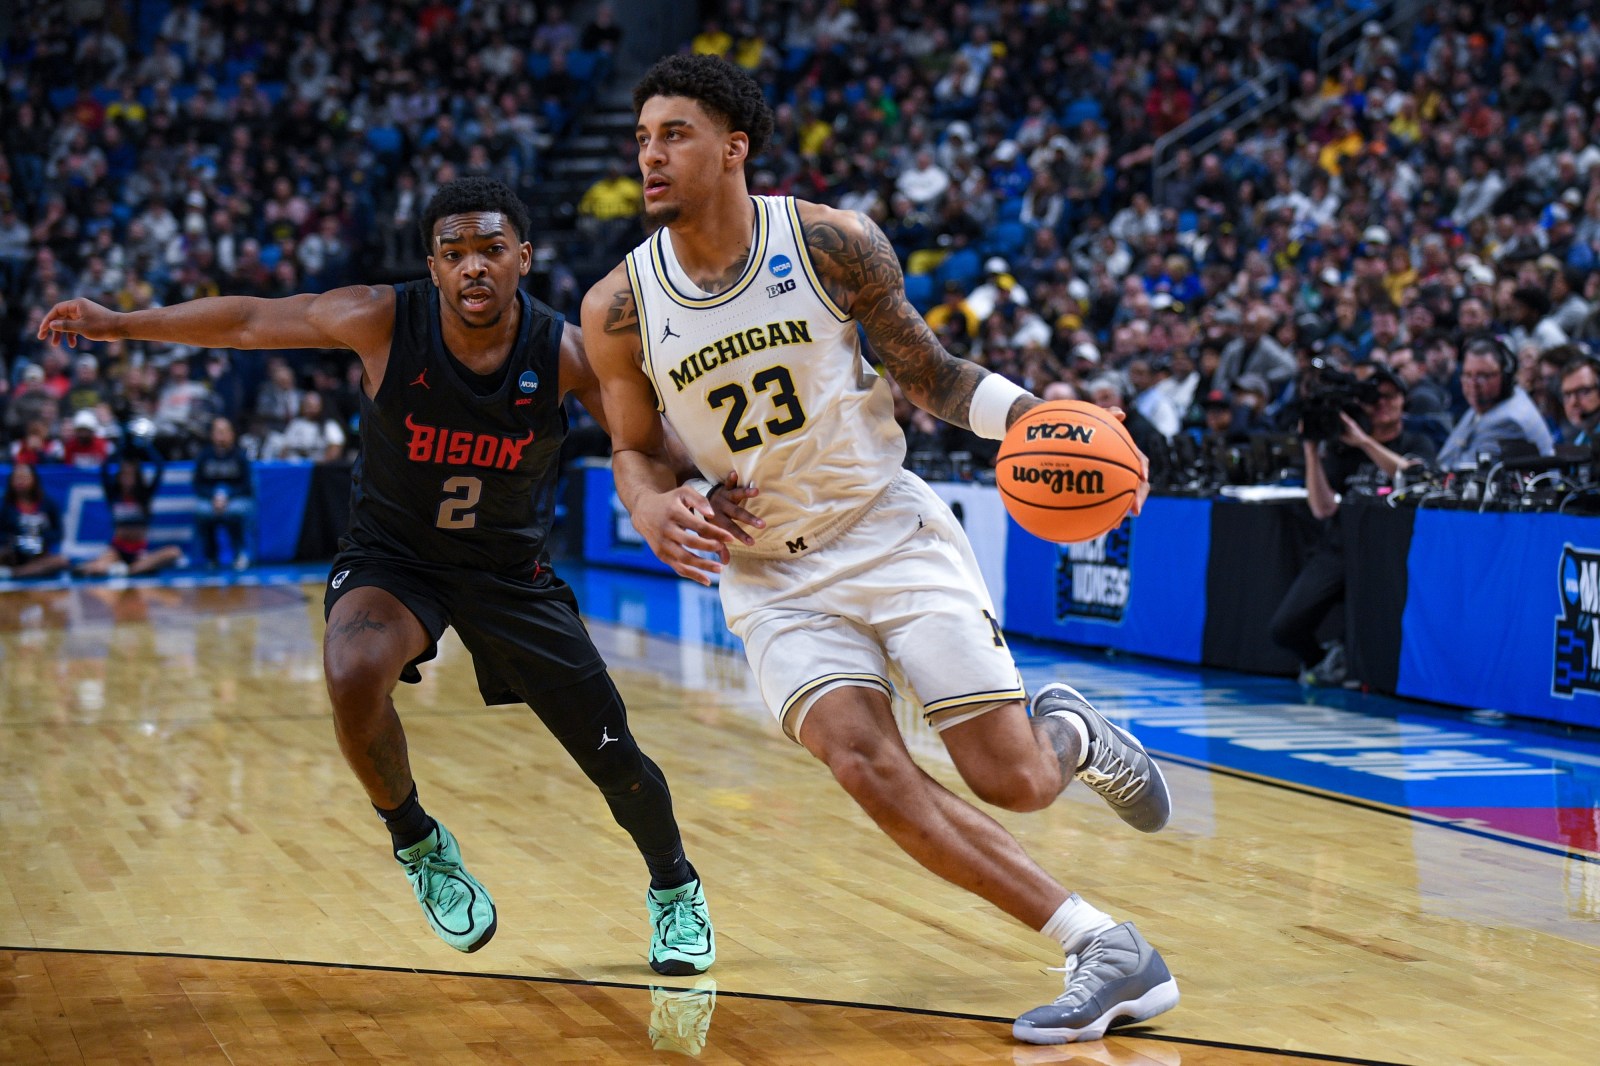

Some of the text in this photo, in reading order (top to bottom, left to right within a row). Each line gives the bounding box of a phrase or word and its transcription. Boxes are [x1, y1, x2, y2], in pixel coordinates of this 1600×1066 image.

[667, 320, 813, 393] MICHIGAN
[707, 365, 806, 453] 23
[1025, 423, 1095, 444] NCAA
[404, 413, 534, 471] BISON
[435, 476, 482, 529] 2
[1012, 465, 1105, 494] Wilson
[785, 536, 808, 553] M
